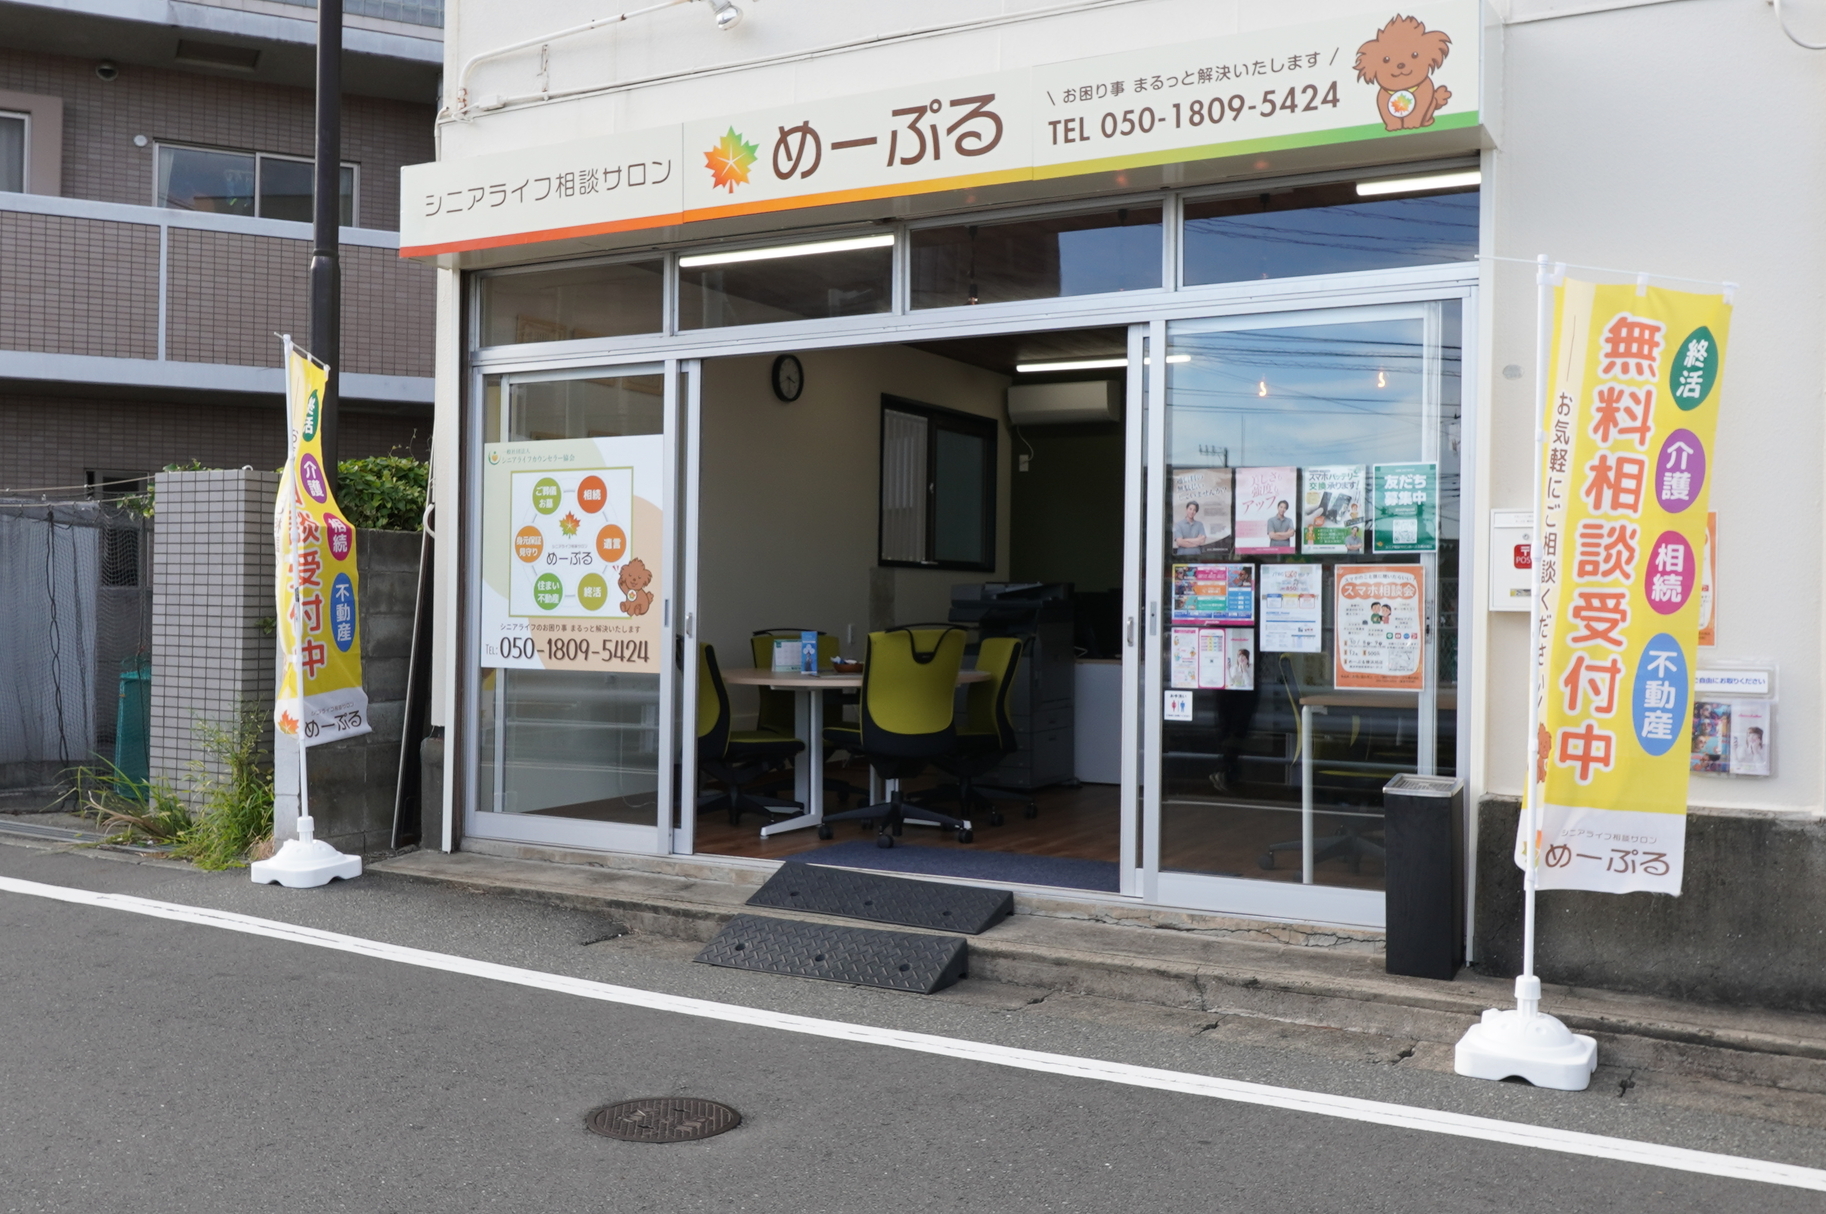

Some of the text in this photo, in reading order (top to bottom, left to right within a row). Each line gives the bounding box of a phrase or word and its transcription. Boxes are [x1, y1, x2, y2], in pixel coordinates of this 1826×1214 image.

[1063, 51, 1320, 104] お困り事 まるっと解決いたします
[1048, 81, 1340, 146] TEL 050-1809-5424
[772, 93, 1004, 181] めーぷる
[425, 159, 672, 217] シニアライフ相談サロン
[1676, 339, 1709, 399] 終活
[304, 460, 324, 497] 介護
[1308, 472, 1360, 481] スマホバッテリー
[1384, 474, 1427, 490] 友だち
[1661, 441, 1694, 501] 介護
[583, 489, 601, 500] 相続
[1384, 490, 1427, 506] 募集中
[328, 517, 348, 553] 相続
[516, 536, 542, 545] 身元保証
[519, 547, 538, 557] 見守り
[546, 551, 593, 566] めーぷる
[1515, 556, 1531, 564] POS
[1558, 316, 1662, 782] 無料相談受付中
[537, 581, 560, 591] 住まい
[1651, 543, 1685, 603] 相続
[537, 593, 560, 604] 不動産
[583, 586, 602, 598] 終活
[1344, 584, 1415, 597] スマホ相談会
[335, 583, 352, 642] 不動産
[500, 623, 641, 634] シニアライフのお困り事 まるっと解決いたします
[500, 636, 650, 663] 050-1809-5424
[1641, 650, 1678, 740] 不動産
[305, 710, 362, 738] めーぷる
[1560, 828, 1657, 844] シニアライフ相談サロン
[1545, 843, 1670, 876] めーぷる
